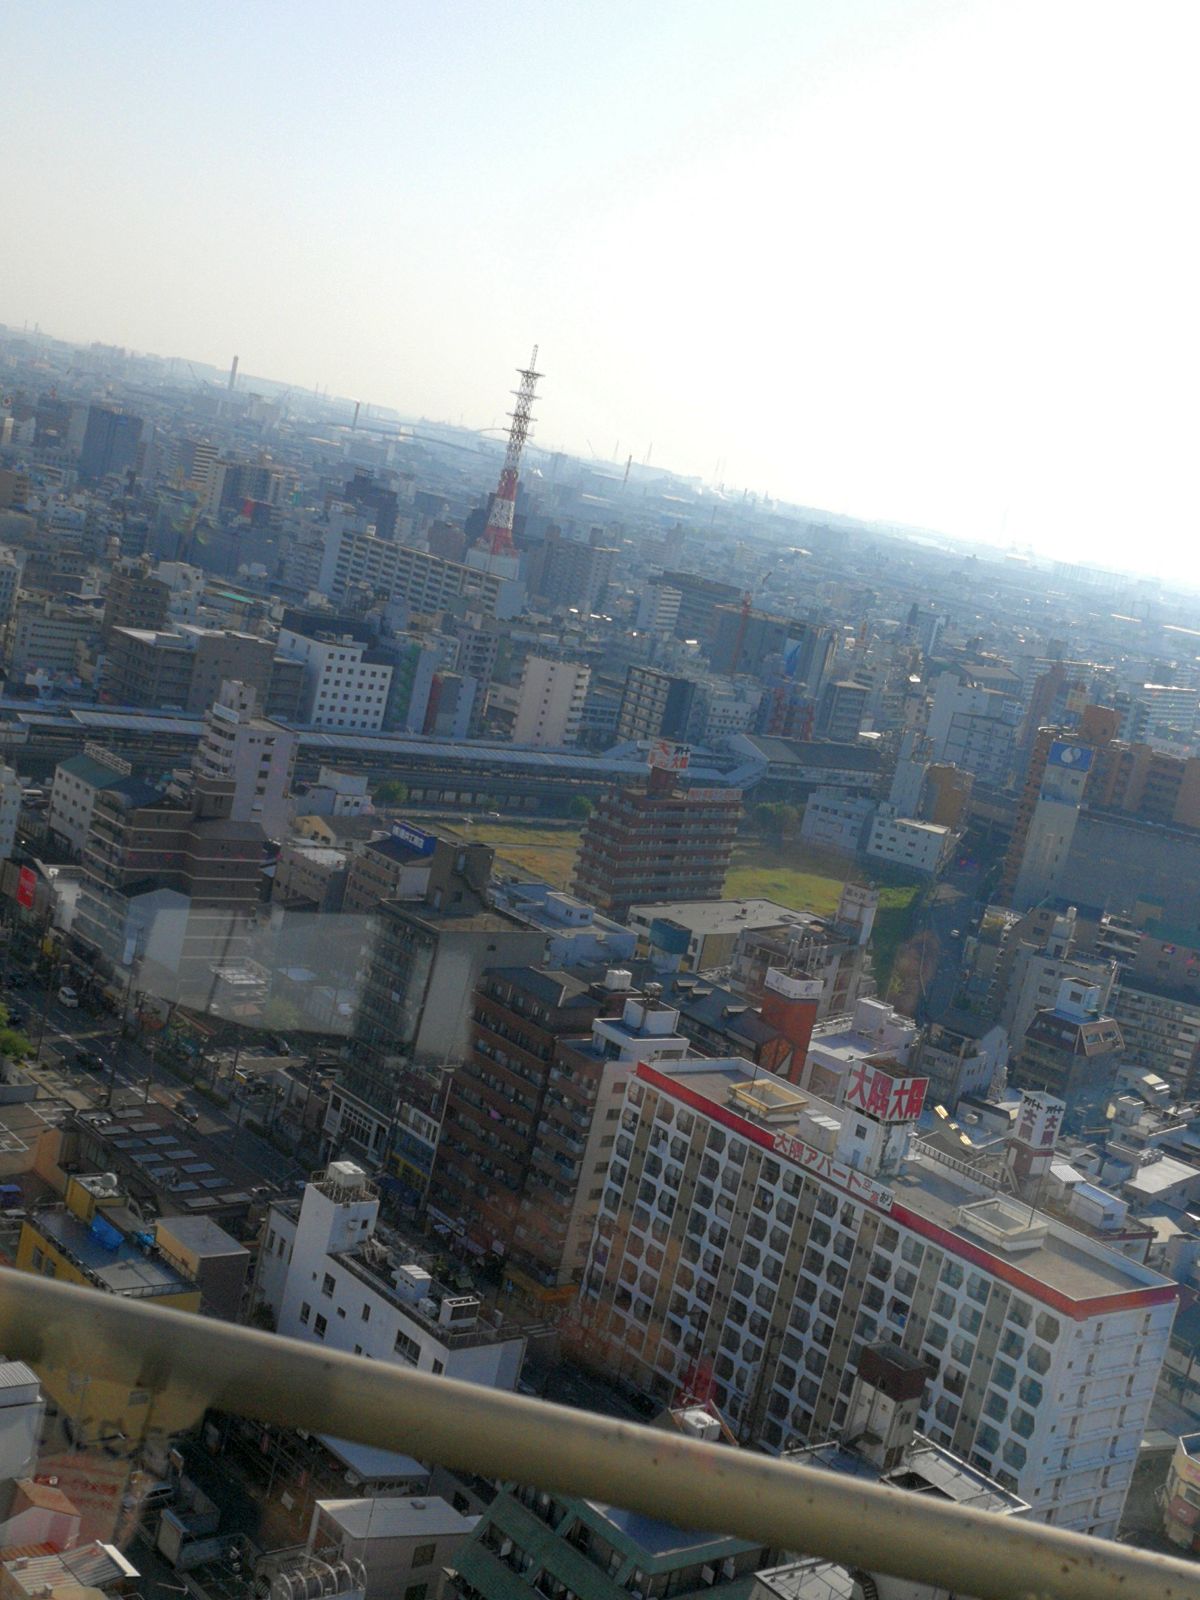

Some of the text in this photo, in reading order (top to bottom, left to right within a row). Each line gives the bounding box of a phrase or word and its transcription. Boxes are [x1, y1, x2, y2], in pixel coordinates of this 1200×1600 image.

[847, 1063, 894, 1119] 大隅
[775, 1132, 862, 1189] 大隅アパート
